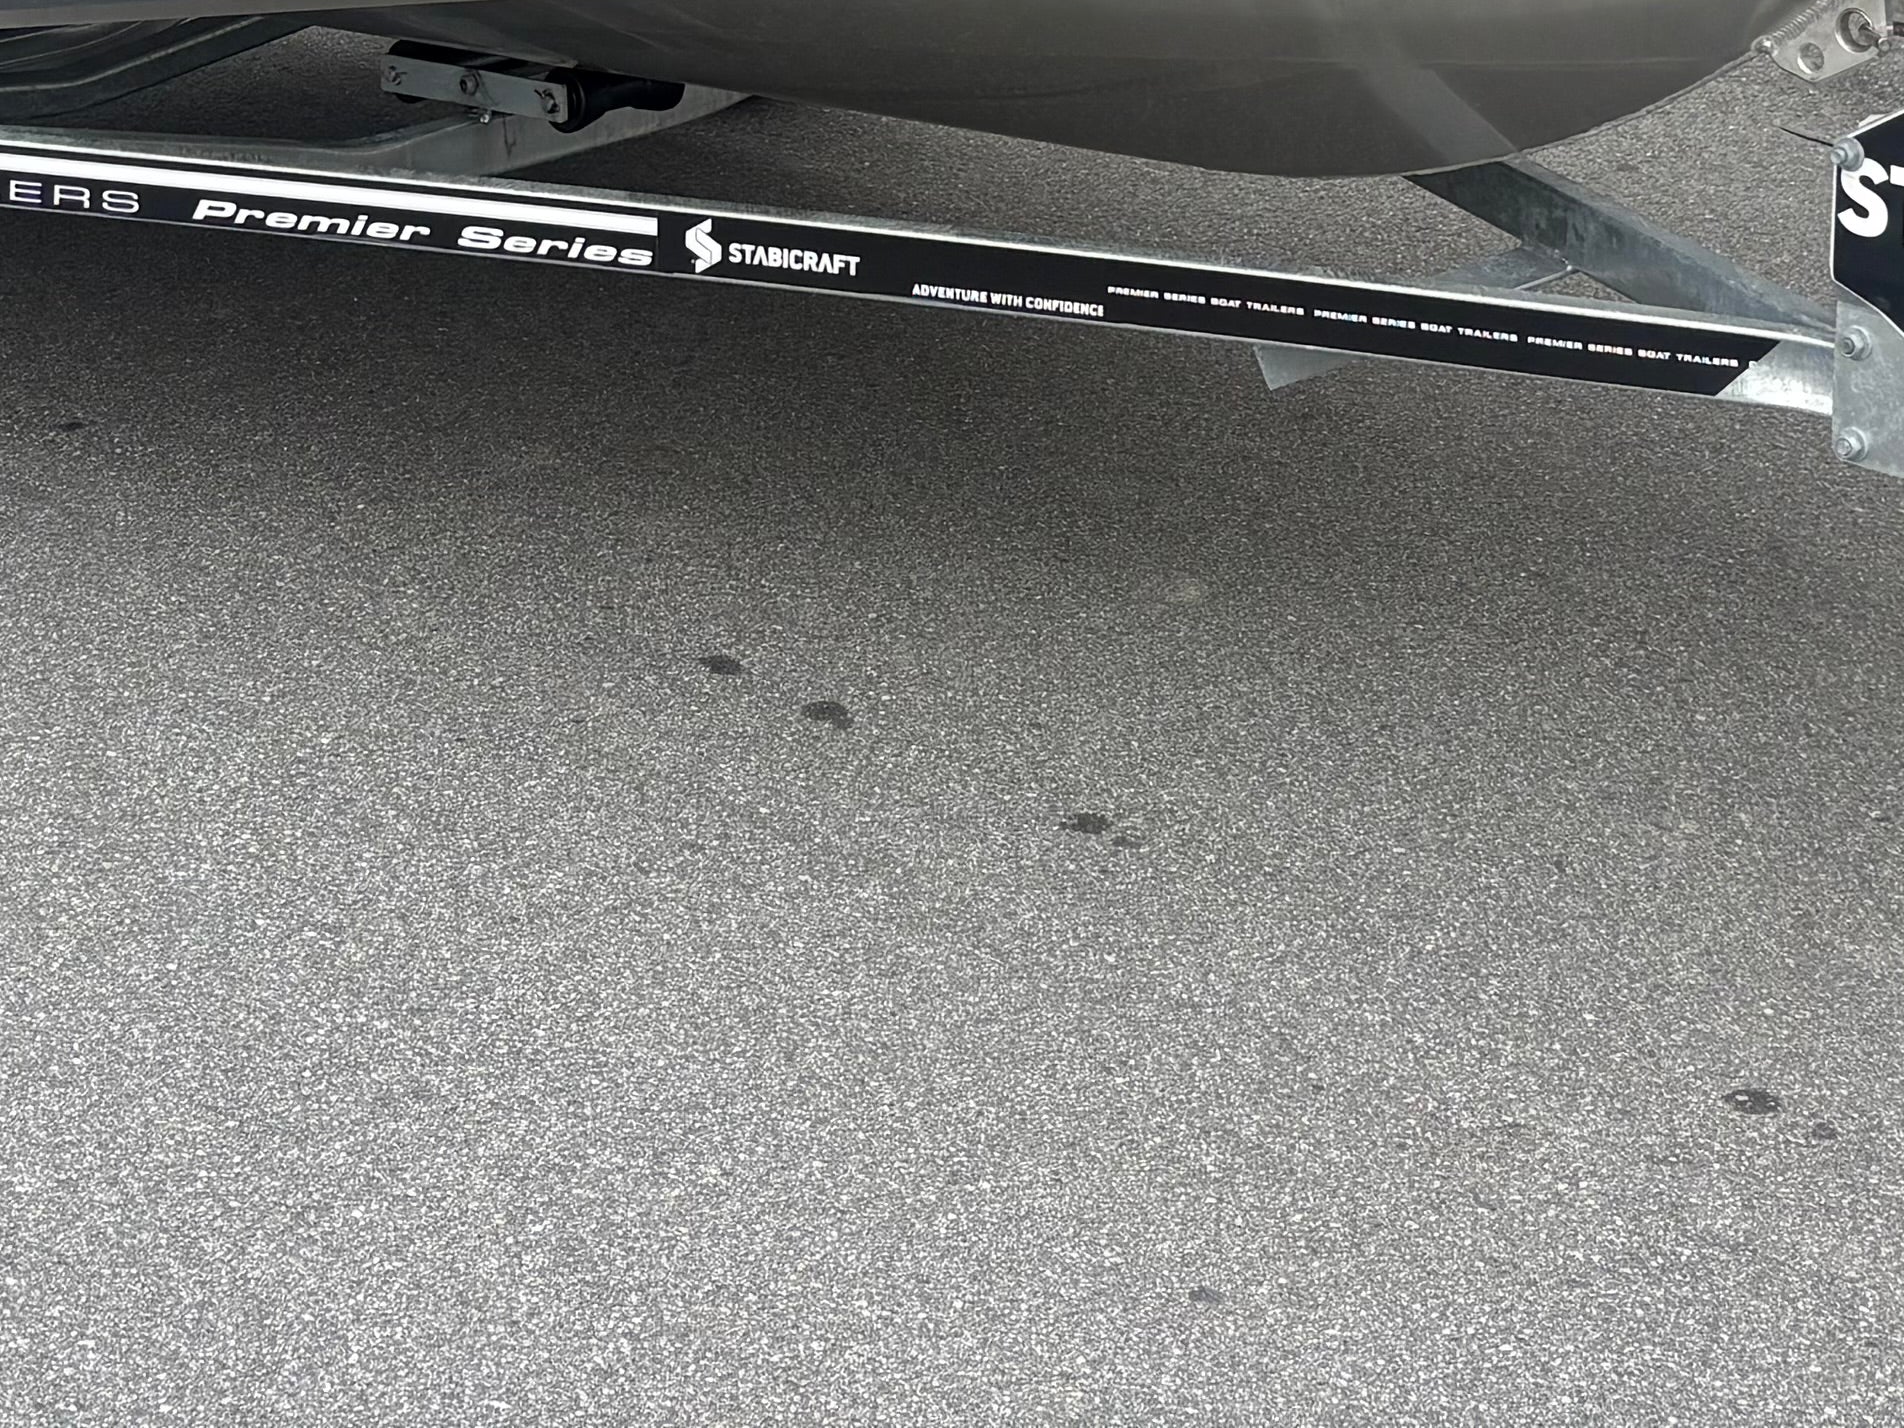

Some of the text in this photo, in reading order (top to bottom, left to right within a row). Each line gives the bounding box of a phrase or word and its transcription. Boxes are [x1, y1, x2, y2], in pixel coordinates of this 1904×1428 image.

[191, 198, 431, 241] Premier
[457, 225, 654, 267] Series
[727, 241, 861, 277] STABICRAFT
[911, 282, 1105, 318] ADVENTURE WITH CONFIDENCE
[1106, 285, 1160, 300] PREMIER
[1162, 291, 1207, 305] SERIES
[1209, 296, 1242, 309] BOAT
[1245, 300, 1306, 317] TRAILERS
[1313, 308, 1368, 324] PREMIER
[1371, 316, 1417, 330] SERIES
[1419, 322, 1454, 334] BOAT
[1457, 327, 1519, 343] TRAILERS
[1526, 335, 1584, 351] PREMIER
[1586, 343, 1634, 357] SERIES
[1637, 349, 1672, 361] BOAT
[1675, 353, 1740, 369] TRAILERS
